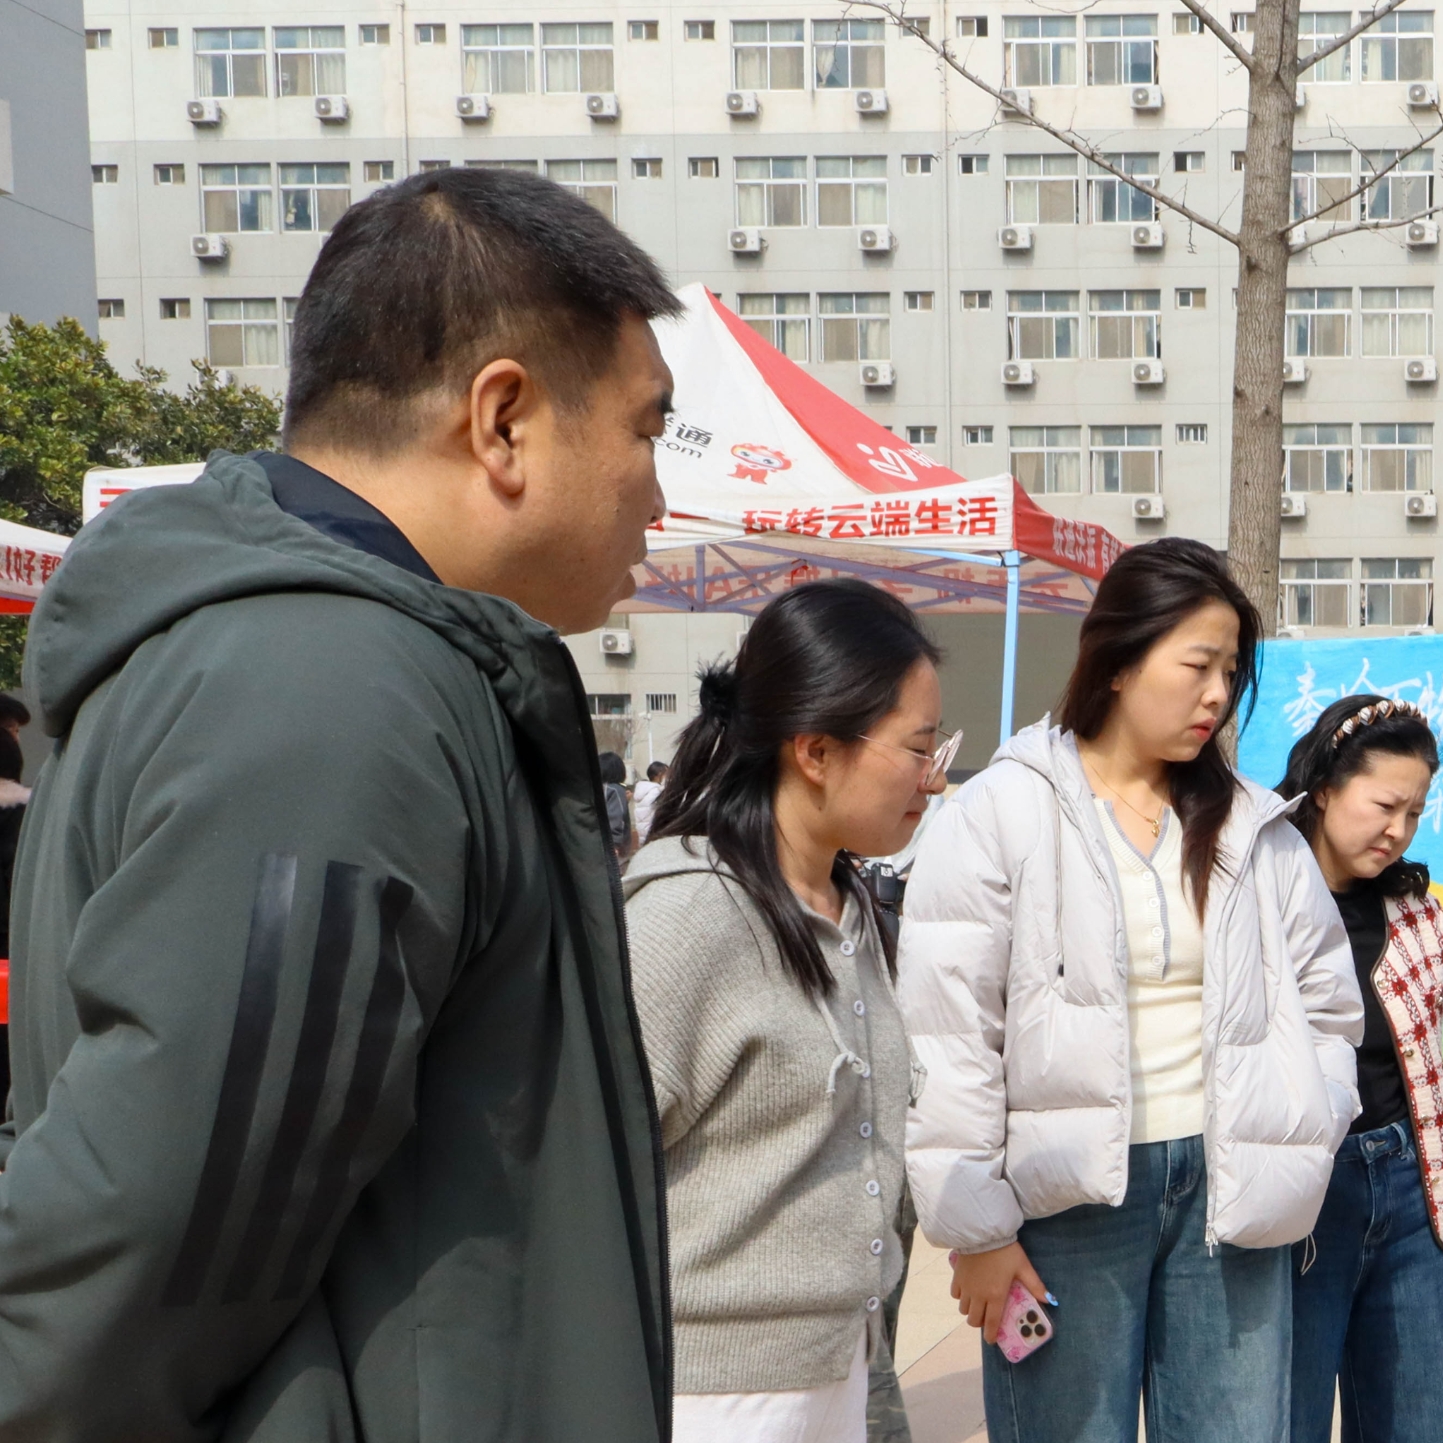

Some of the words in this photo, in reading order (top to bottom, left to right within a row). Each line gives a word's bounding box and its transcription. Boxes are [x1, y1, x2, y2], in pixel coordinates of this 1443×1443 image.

[741, 495, 998, 540] 玩转云端生活
